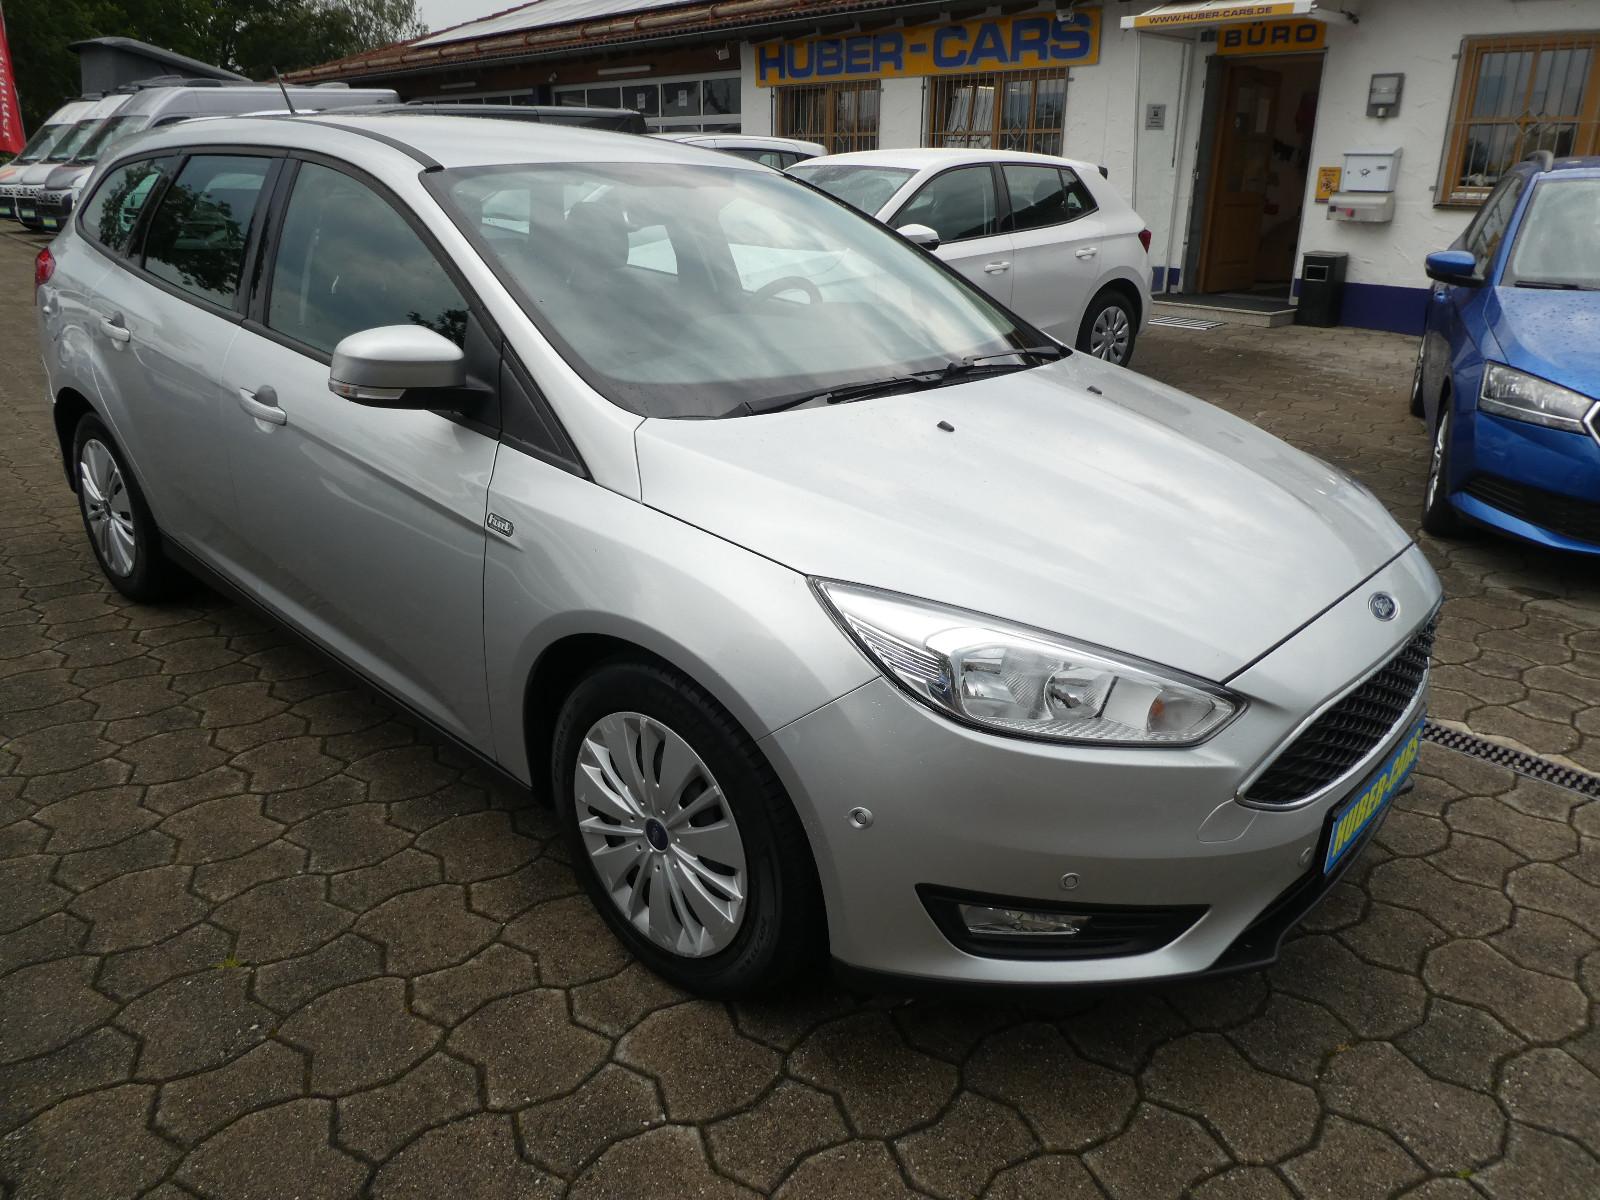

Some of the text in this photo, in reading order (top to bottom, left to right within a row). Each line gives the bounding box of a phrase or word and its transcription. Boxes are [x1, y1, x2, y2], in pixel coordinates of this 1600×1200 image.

[1150, 6, 1273, 24] WWW.HUBER-CARS.DE
[759, 12, 1092, 81] HUBER-CARS
[1224, 22, 1317, 47] BÜRO
